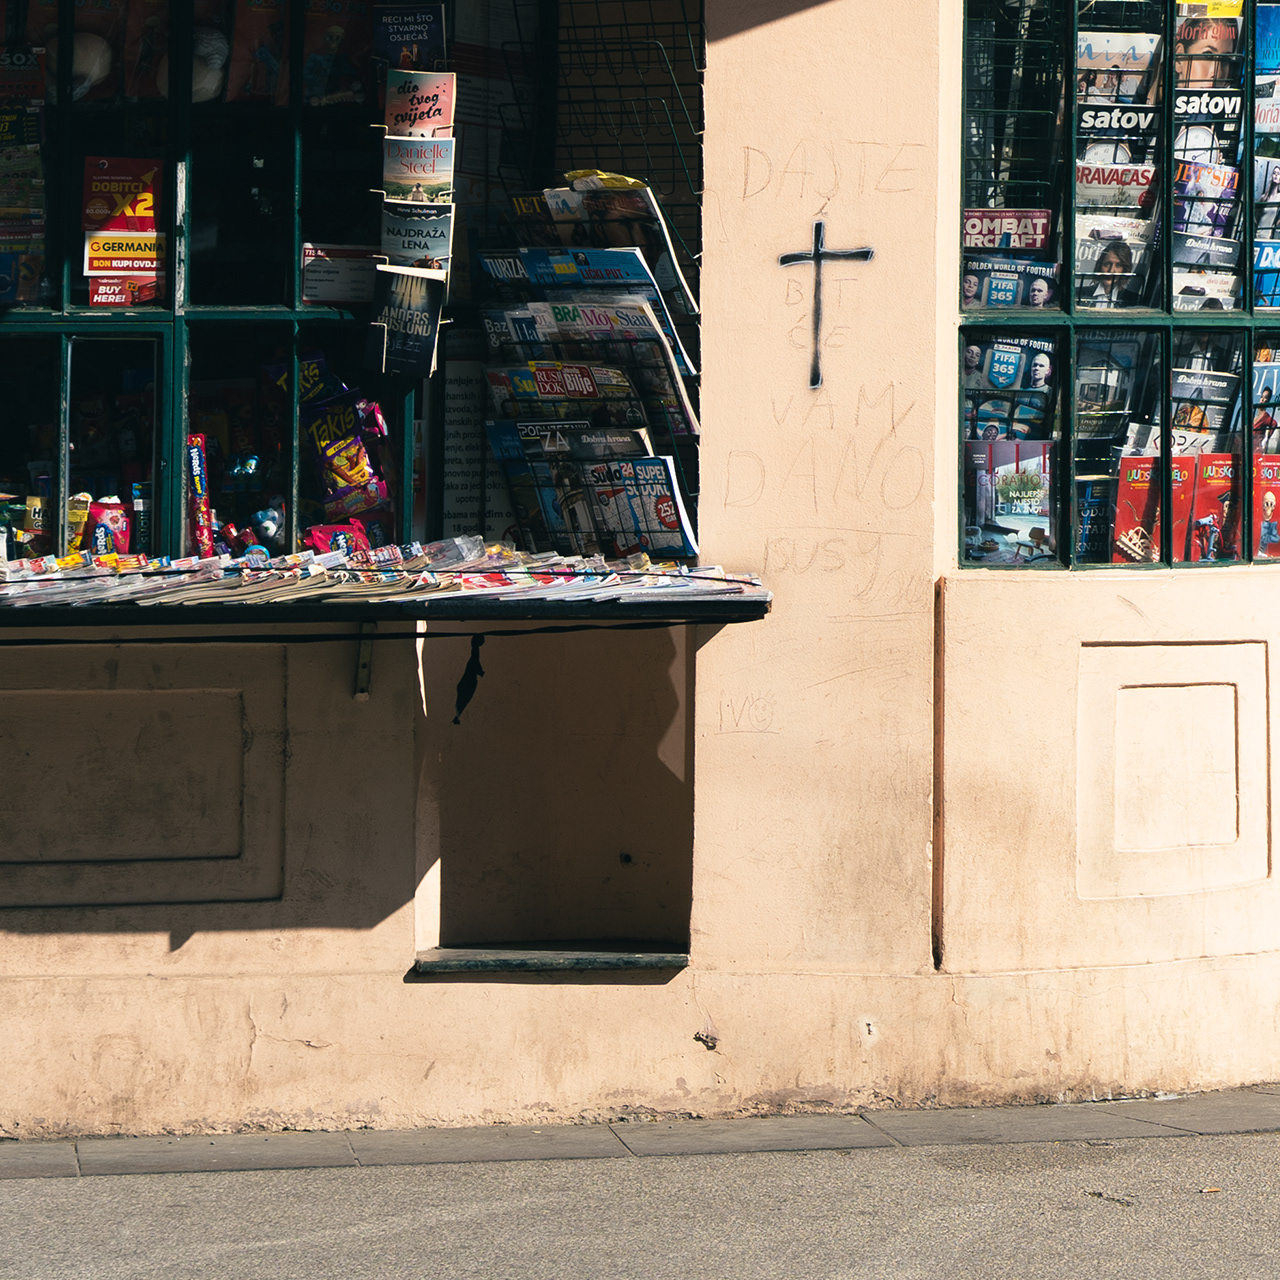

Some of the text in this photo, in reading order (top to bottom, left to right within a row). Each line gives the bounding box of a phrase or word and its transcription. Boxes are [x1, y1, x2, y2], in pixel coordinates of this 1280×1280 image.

[403, 14, 414, 22] MI
[416, 12, 434, 22] ŠTO
[388, 24, 429, 33] STVARNO
[1176, 21, 1238, 42] gloria glow
[389, 32, 428, 42] OSJEĆAŠ
[397, 80, 420, 94] dio
[409, 92, 439, 108] tvog
[1174, 92, 1242, 115] satovi
[393, 105, 443, 128] svijeta
[387, 142, 449, 159] Danielle
[399, 158, 436, 174] Steel
[739, 137, 929, 203] DAJTE
[92, 182, 143, 193] DOBITCI
[111, 192, 154, 216] X2
[386, 226, 446, 239] NAJDRAŽA
[102, 242, 165, 252] GERMANIA
[402, 240, 430, 250] LENA
[1185, 238, 1234, 254] Dobra hrana
[92, 260, 111, 268] BON
[112, 260, 132, 268] KUPI
[967, 261, 992, 270] GOLDEN
[994, 262, 1016, 272] WORLD
[1016, 264, 1026, 272] OF
[606, 268, 624, 280] PUT
[98, 286, 122, 294] BUY
[992, 281, 1014, 290] FIFA
[92, 294, 126, 303] HERE!
[990, 291, 1013, 301] 365
[580, 308, 652, 330] Moj Stan
[1020, 338, 1028, 346] OF
[994, 353, 1016, 364] FIFA
[992, 364, 1015, 374] 365
[562, 372, 594, 395] Bilje
[1176, 374, 1228, 388] Dobra hrana
[769, 380, 896, 437] VAM
[308, 406, 356, 456] Takis
[580, 434, 632, 444] Dobra hrana
[190, 448, 200, 476] Nerds
[723, 401, 925, 514] DANO
[1009, 489, 1044, 498] NAJLJEPŠE
[1013, 498, 1040, 506] MJESTO
[656, 502, 676, 518] 252
[1022, 504, 1043, 514] ŽIVOT
[452, 524, 462, 532] 18
